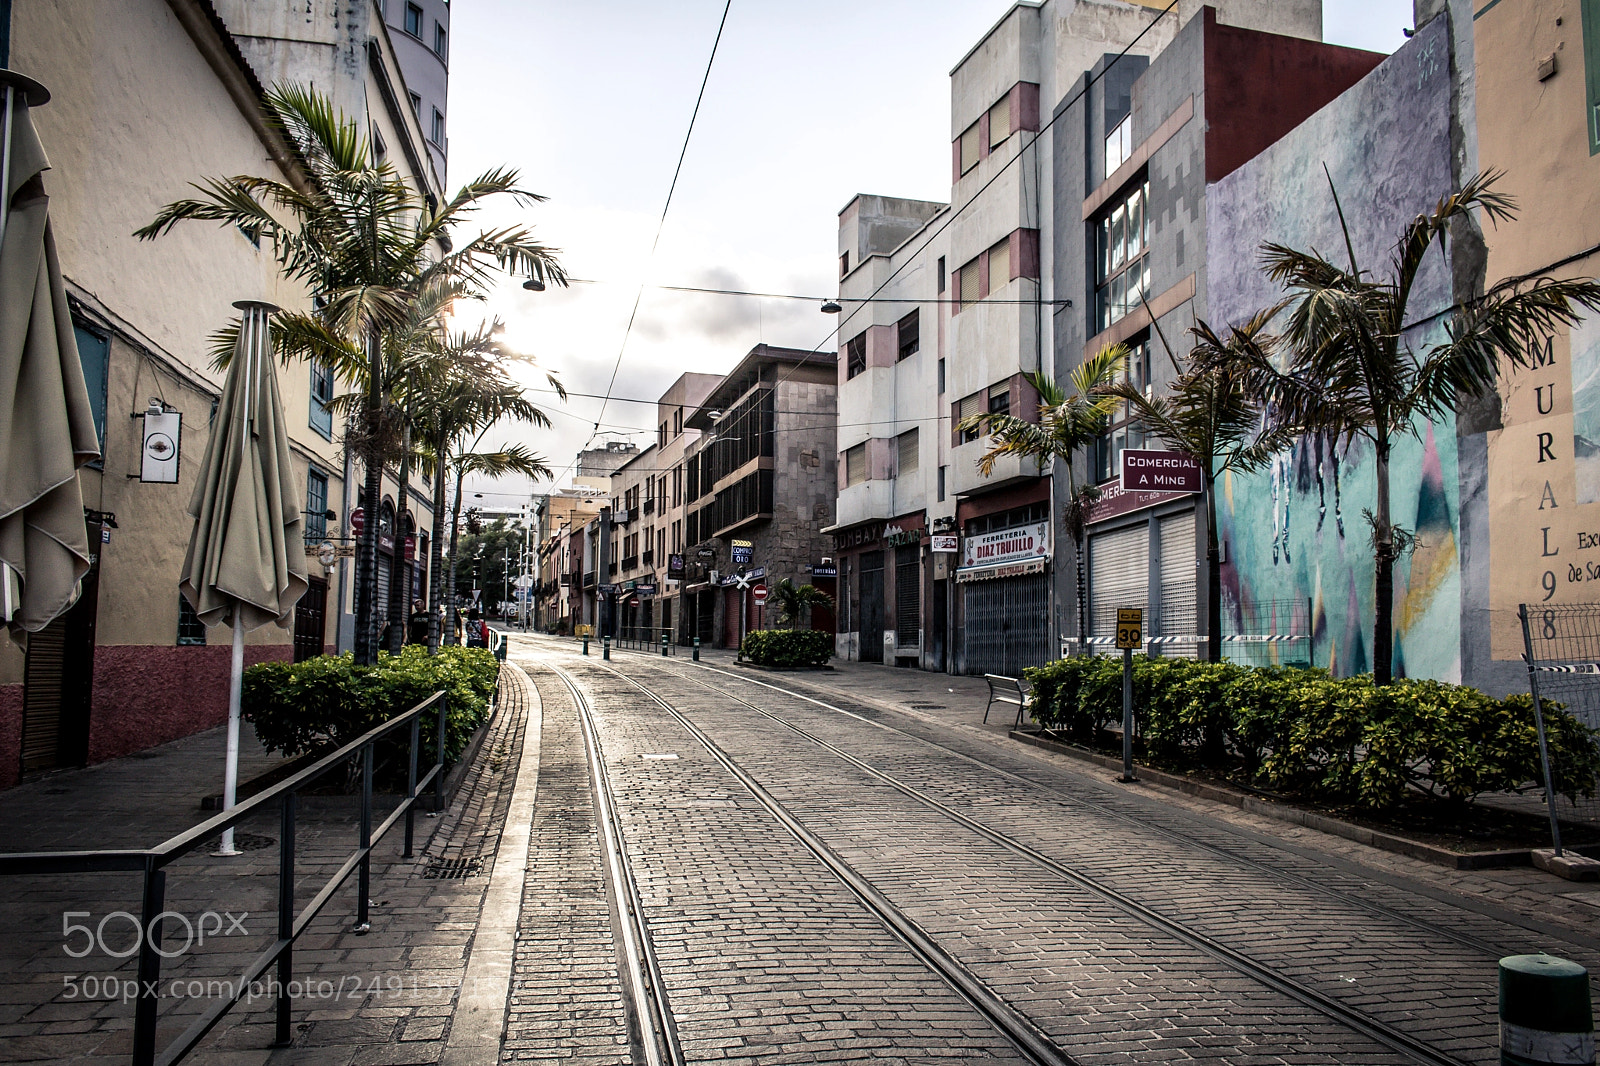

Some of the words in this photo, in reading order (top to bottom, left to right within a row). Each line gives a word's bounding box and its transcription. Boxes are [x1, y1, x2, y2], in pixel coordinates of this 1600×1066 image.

[1127, 456, 1197, 468] COMERCIAL
[1139, 474, 1148, 485] A
[1154, 474, 1186, 485] MING
[888, 529, 920, 548] BAZAR
[982, 530, 1027, 543] FERRETERIA
[977, 541, 995, 558] DIAZ
[996, 536, 1034, 555] TRUJILLO
[736, 555, 749, 563] ORO
[1568, 563, 1583, 583] de
[1119, 629, 1141, 643] 30
